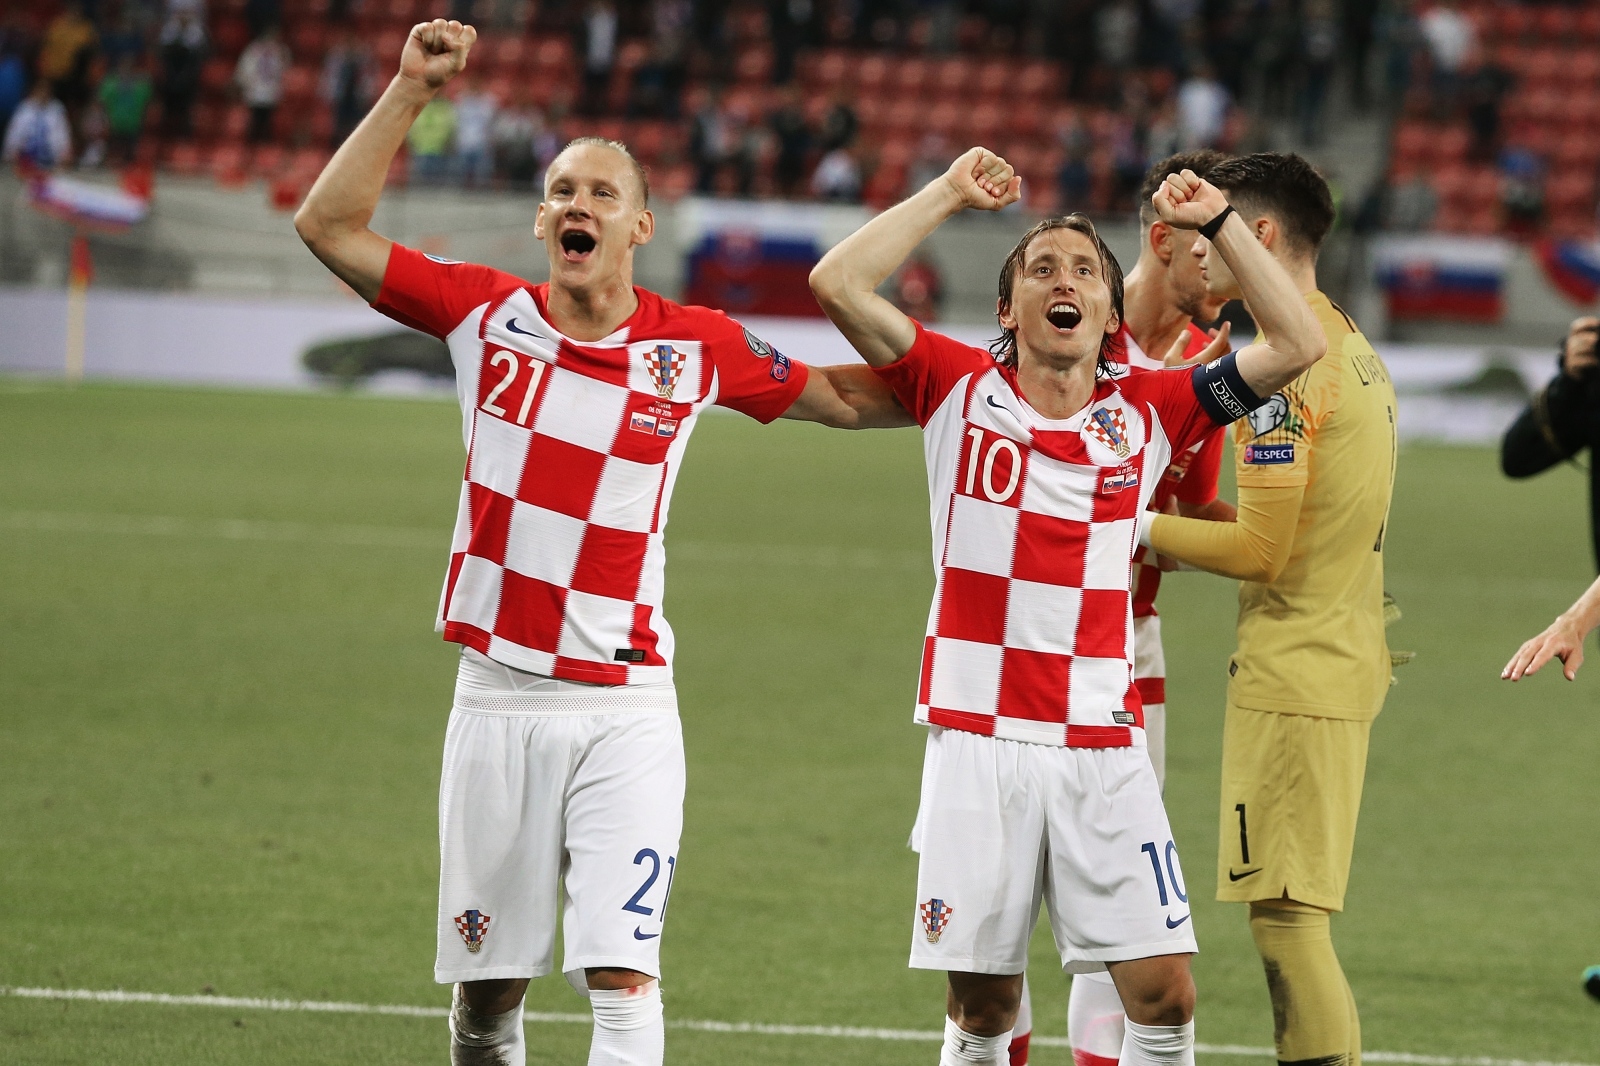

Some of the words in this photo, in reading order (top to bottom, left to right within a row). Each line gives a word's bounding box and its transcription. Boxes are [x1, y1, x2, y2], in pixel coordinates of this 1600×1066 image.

[481, 349, 547, 426] 21
[1211, 380, 1246, 418] RESPECT
[965, 427, 1022, 503] 10
[1254, 449, 1294, 460] RESPECT
[1235, 804, 1250, 865] 1
[621, 847, 675, 922] 21
[1141, 840, 1188, 906] 10
